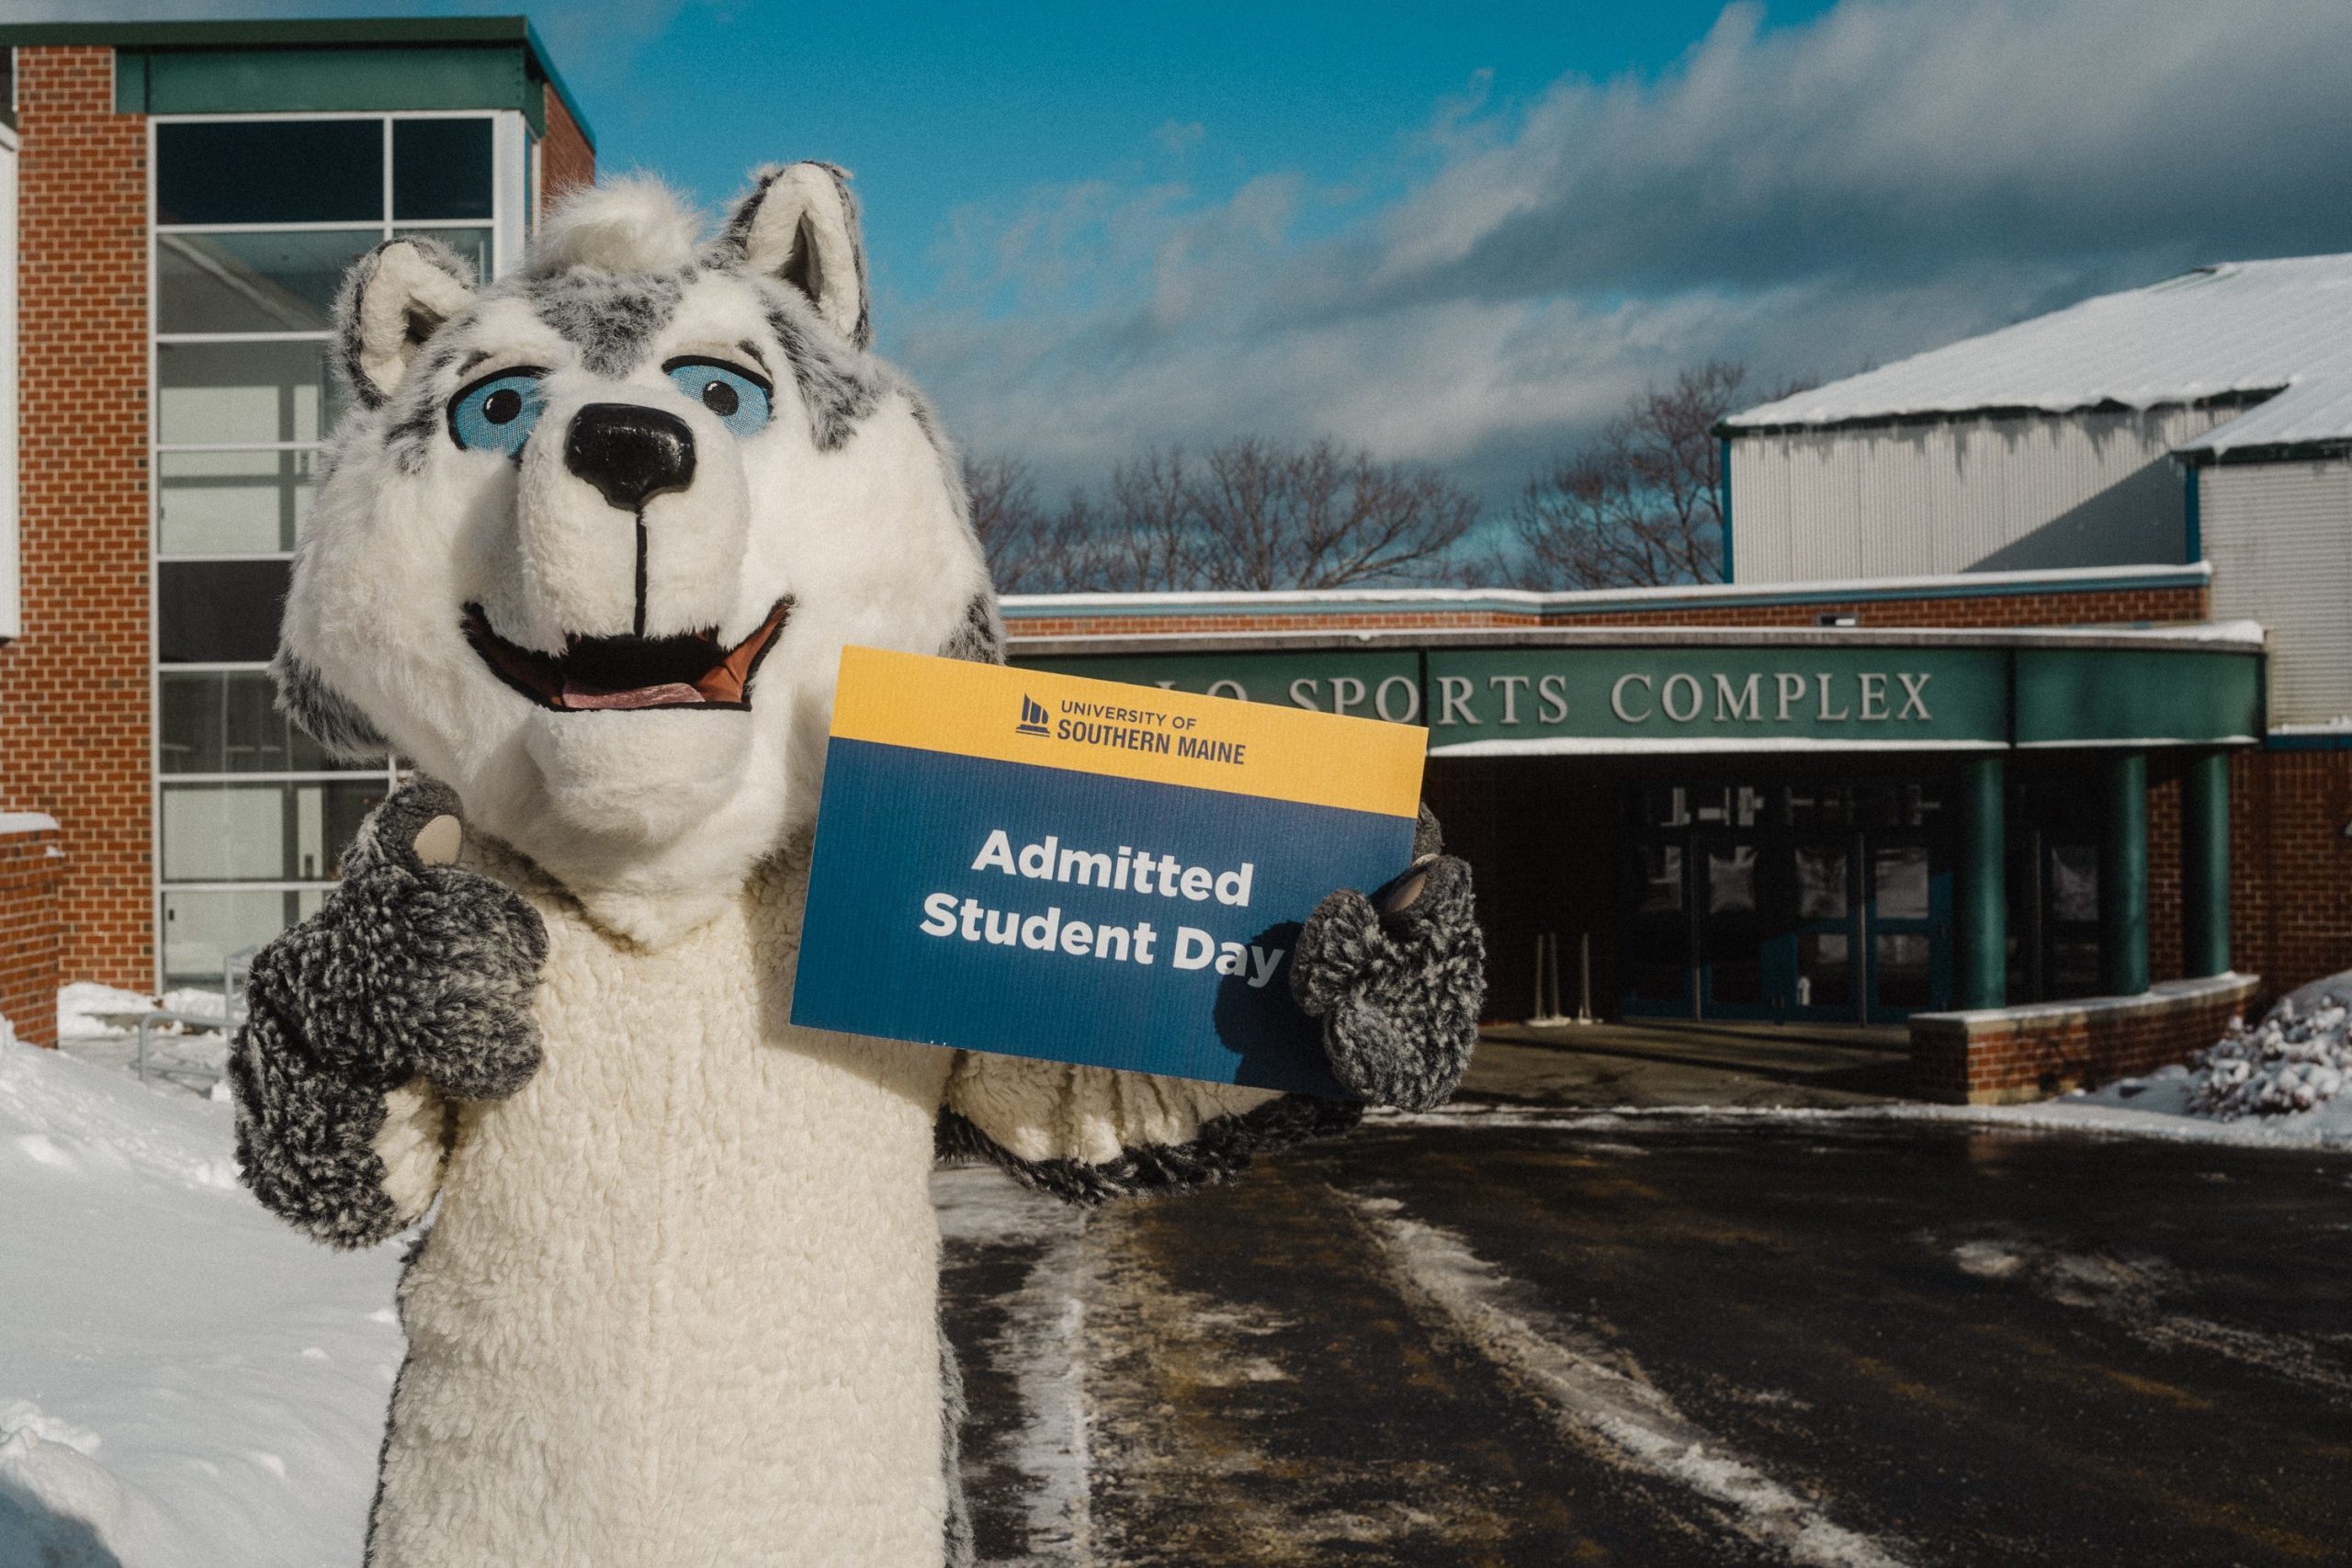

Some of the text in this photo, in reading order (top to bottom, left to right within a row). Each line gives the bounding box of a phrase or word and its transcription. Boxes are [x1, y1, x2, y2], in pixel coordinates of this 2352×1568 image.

[1061, 700, 1197, 731] UNIVERSITY OF
[1289, 675, 1568, 725] SPORTS
[1611, 673, 1932, 723] COMPLEX
[1057, 719, 1246, 765] SOUTHERN MAINE
[971, 829, 1254, 907] Admitted
[920, 892, 1285, 987] Student Day
